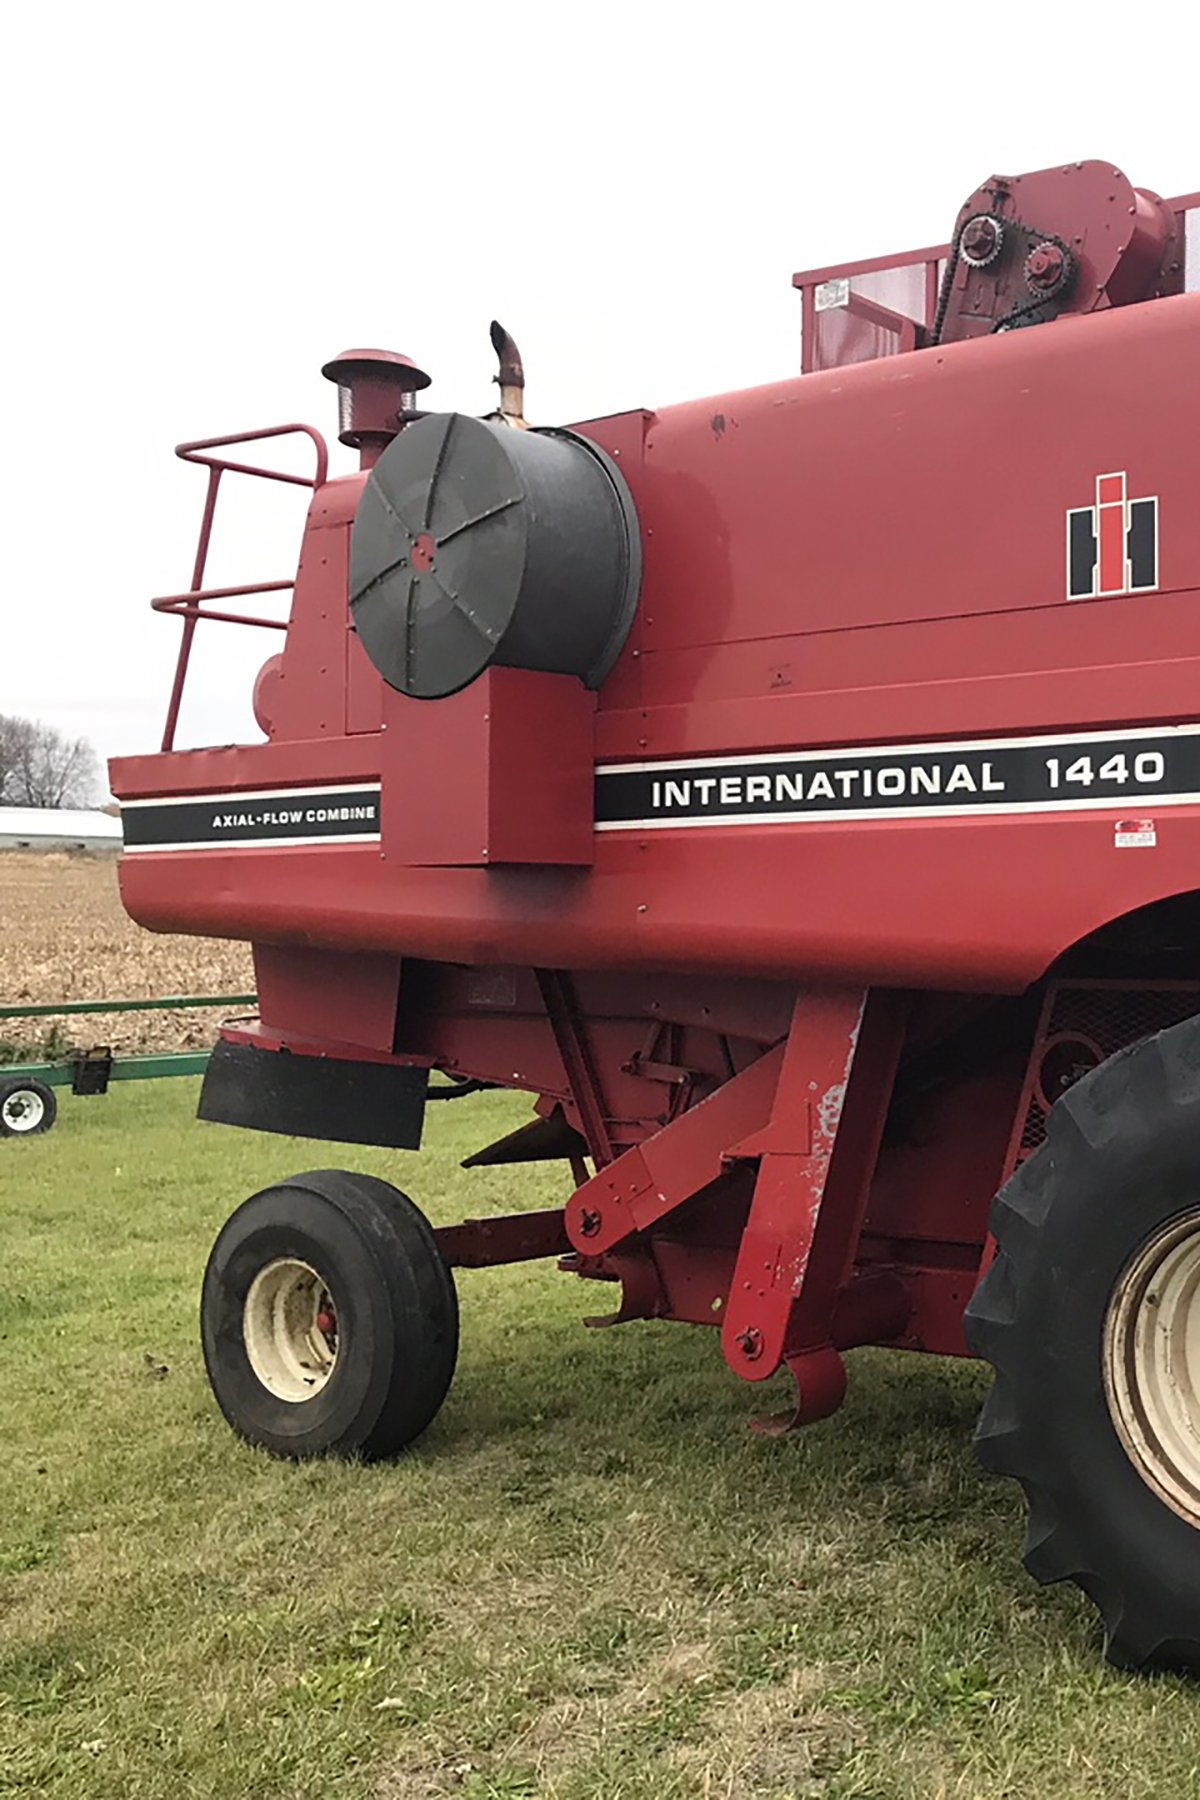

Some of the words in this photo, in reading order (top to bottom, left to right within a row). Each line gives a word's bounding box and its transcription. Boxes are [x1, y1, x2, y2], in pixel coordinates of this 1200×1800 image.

[652, 762, 1005, 807] INTERNATIONAL
[1046, 752, 1164, 788] 1440
[306, 806, 375, 823] COMBINE
